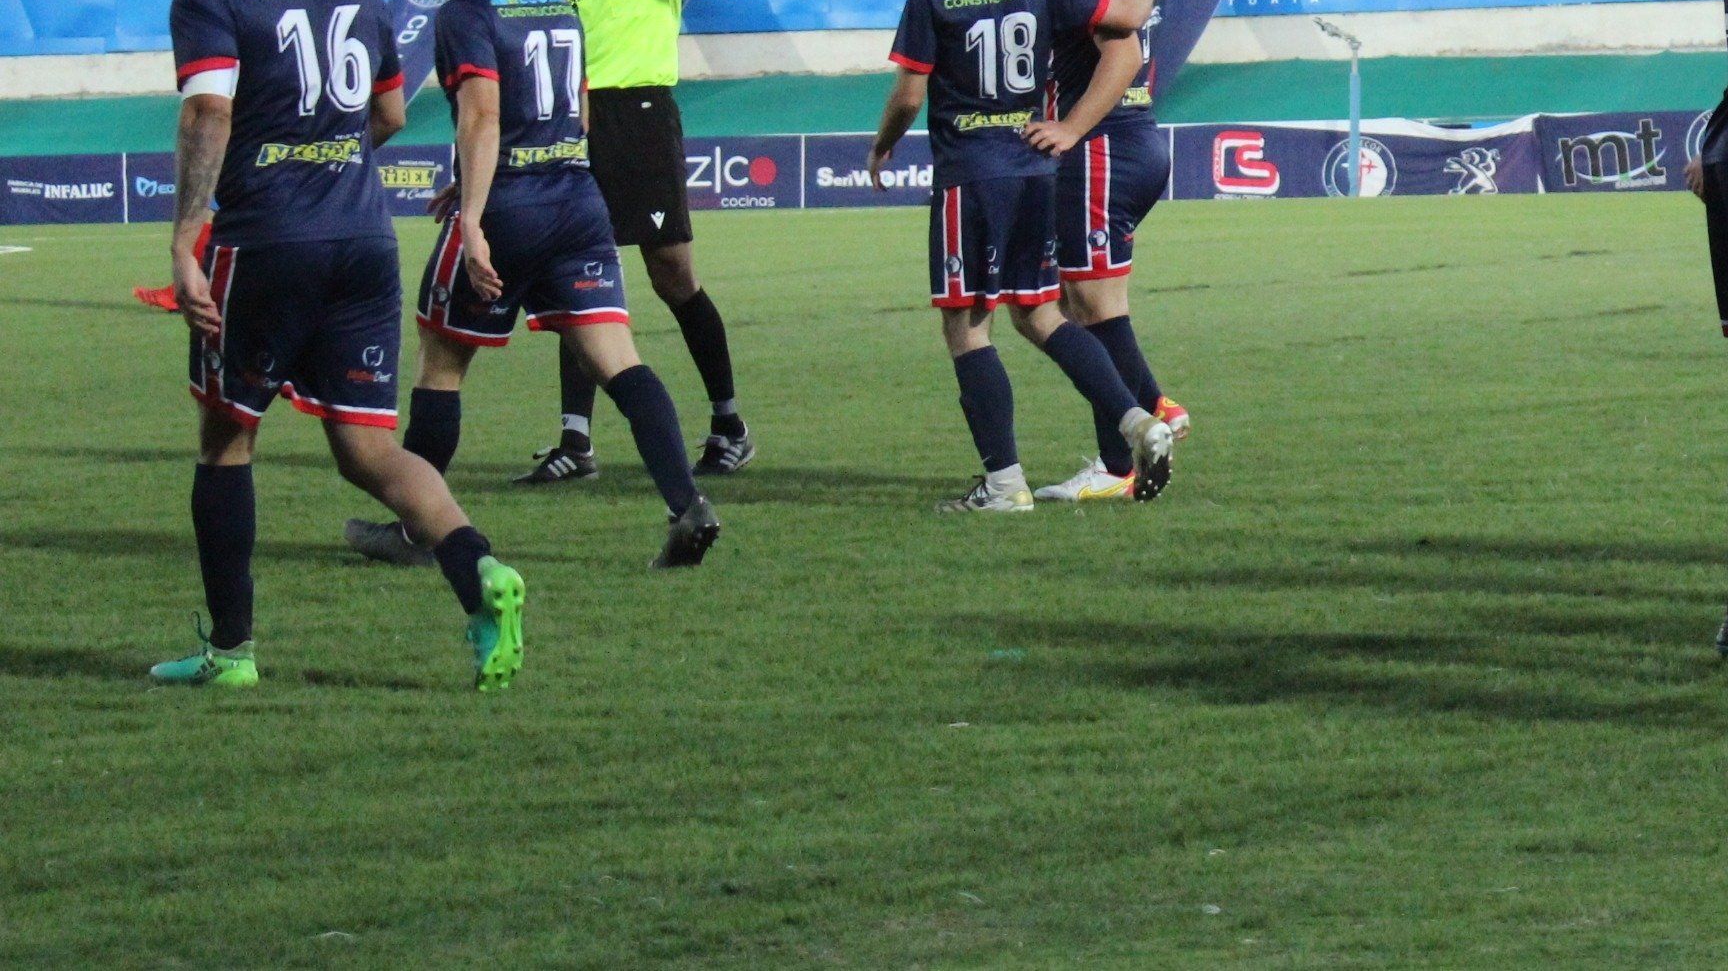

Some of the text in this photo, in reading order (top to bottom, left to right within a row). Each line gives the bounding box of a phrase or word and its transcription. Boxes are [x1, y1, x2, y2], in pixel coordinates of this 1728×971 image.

[276, 4, 371, 116] 16
[524, 29, 583, 121] 17
[966, 11, 1038, 100] 18
[44, 181, 115, 199] INFALUC
[1558, 118, 1667, 188] mt
[721, 194, 776, 208] cocinas
